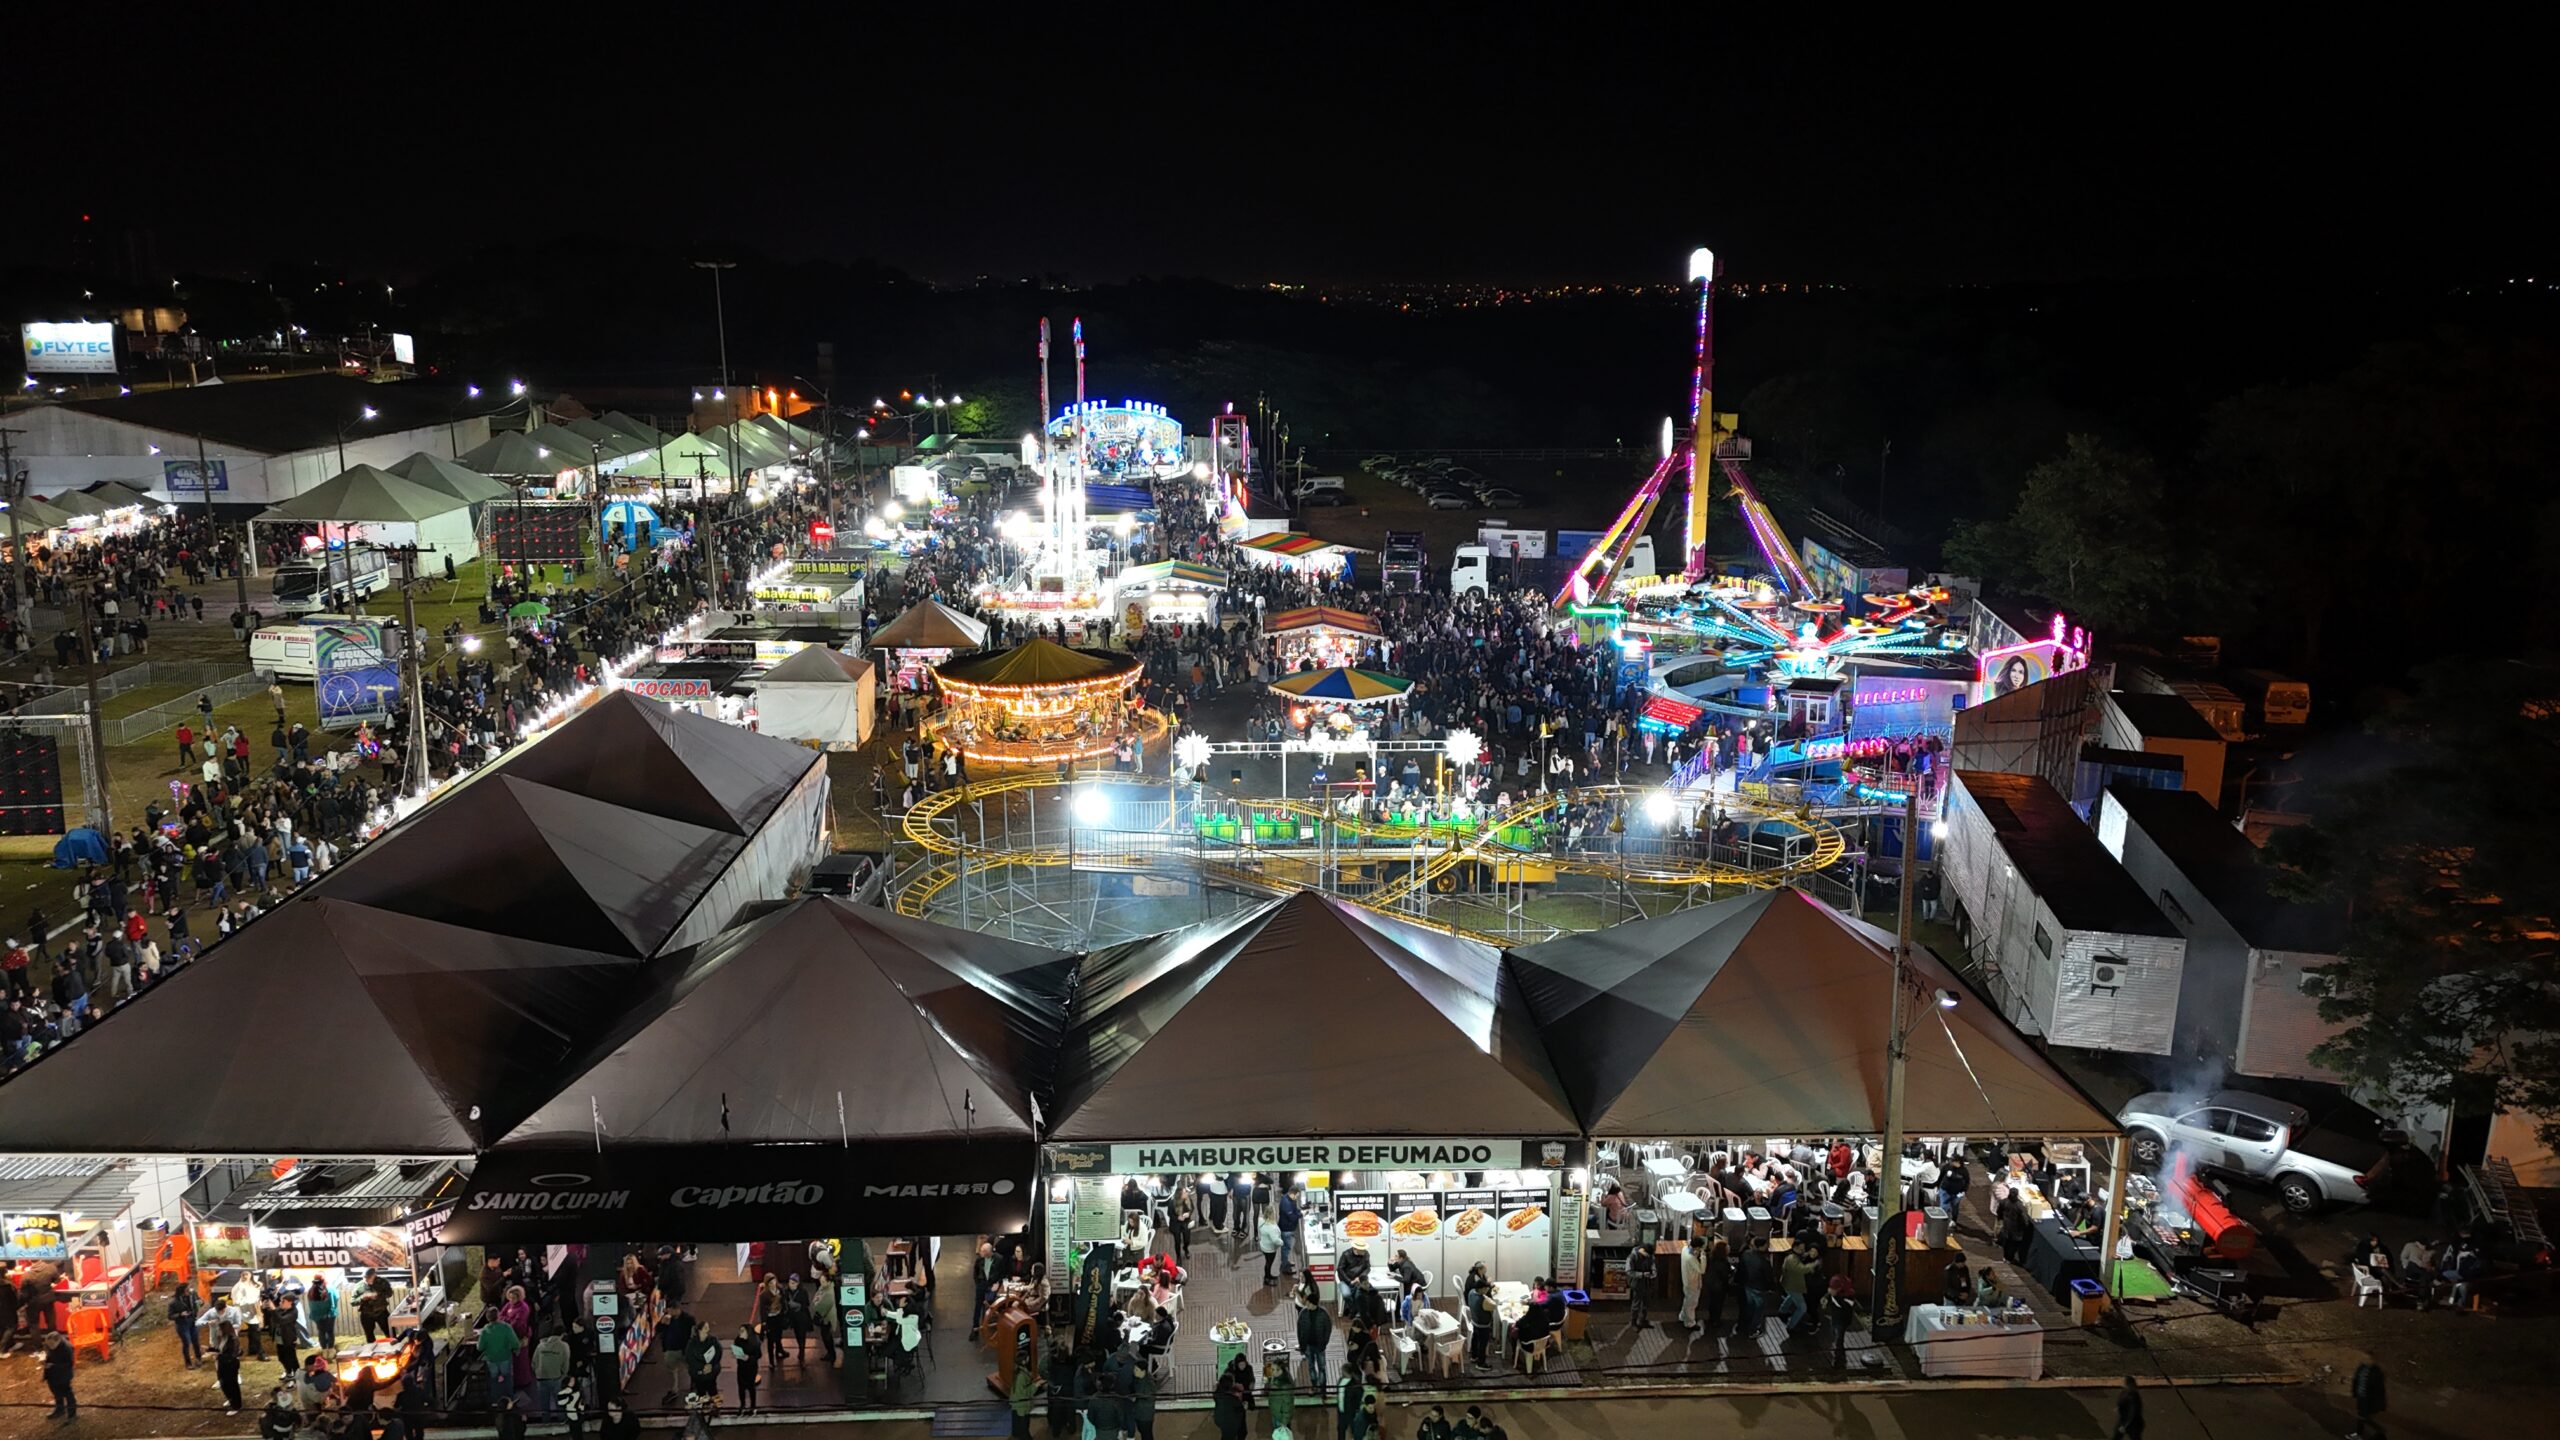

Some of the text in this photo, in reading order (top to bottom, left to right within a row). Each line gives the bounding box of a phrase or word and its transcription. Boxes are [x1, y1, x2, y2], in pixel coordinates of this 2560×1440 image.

[44, 342, 111, 353] FLYTEC
[634, 681, 709, 697] COCADA
[1138, 1145, 1492, 1167] HAMBURGUER DEFUMADO
[670, 1179, 824, 1210] Capitão
[864, 1183, 989, 1197] MAKI 寿司
[467, 1190, 631, 1211] SANTO CUPIM
[279, 1250, 350, 1266] TOLEDO
